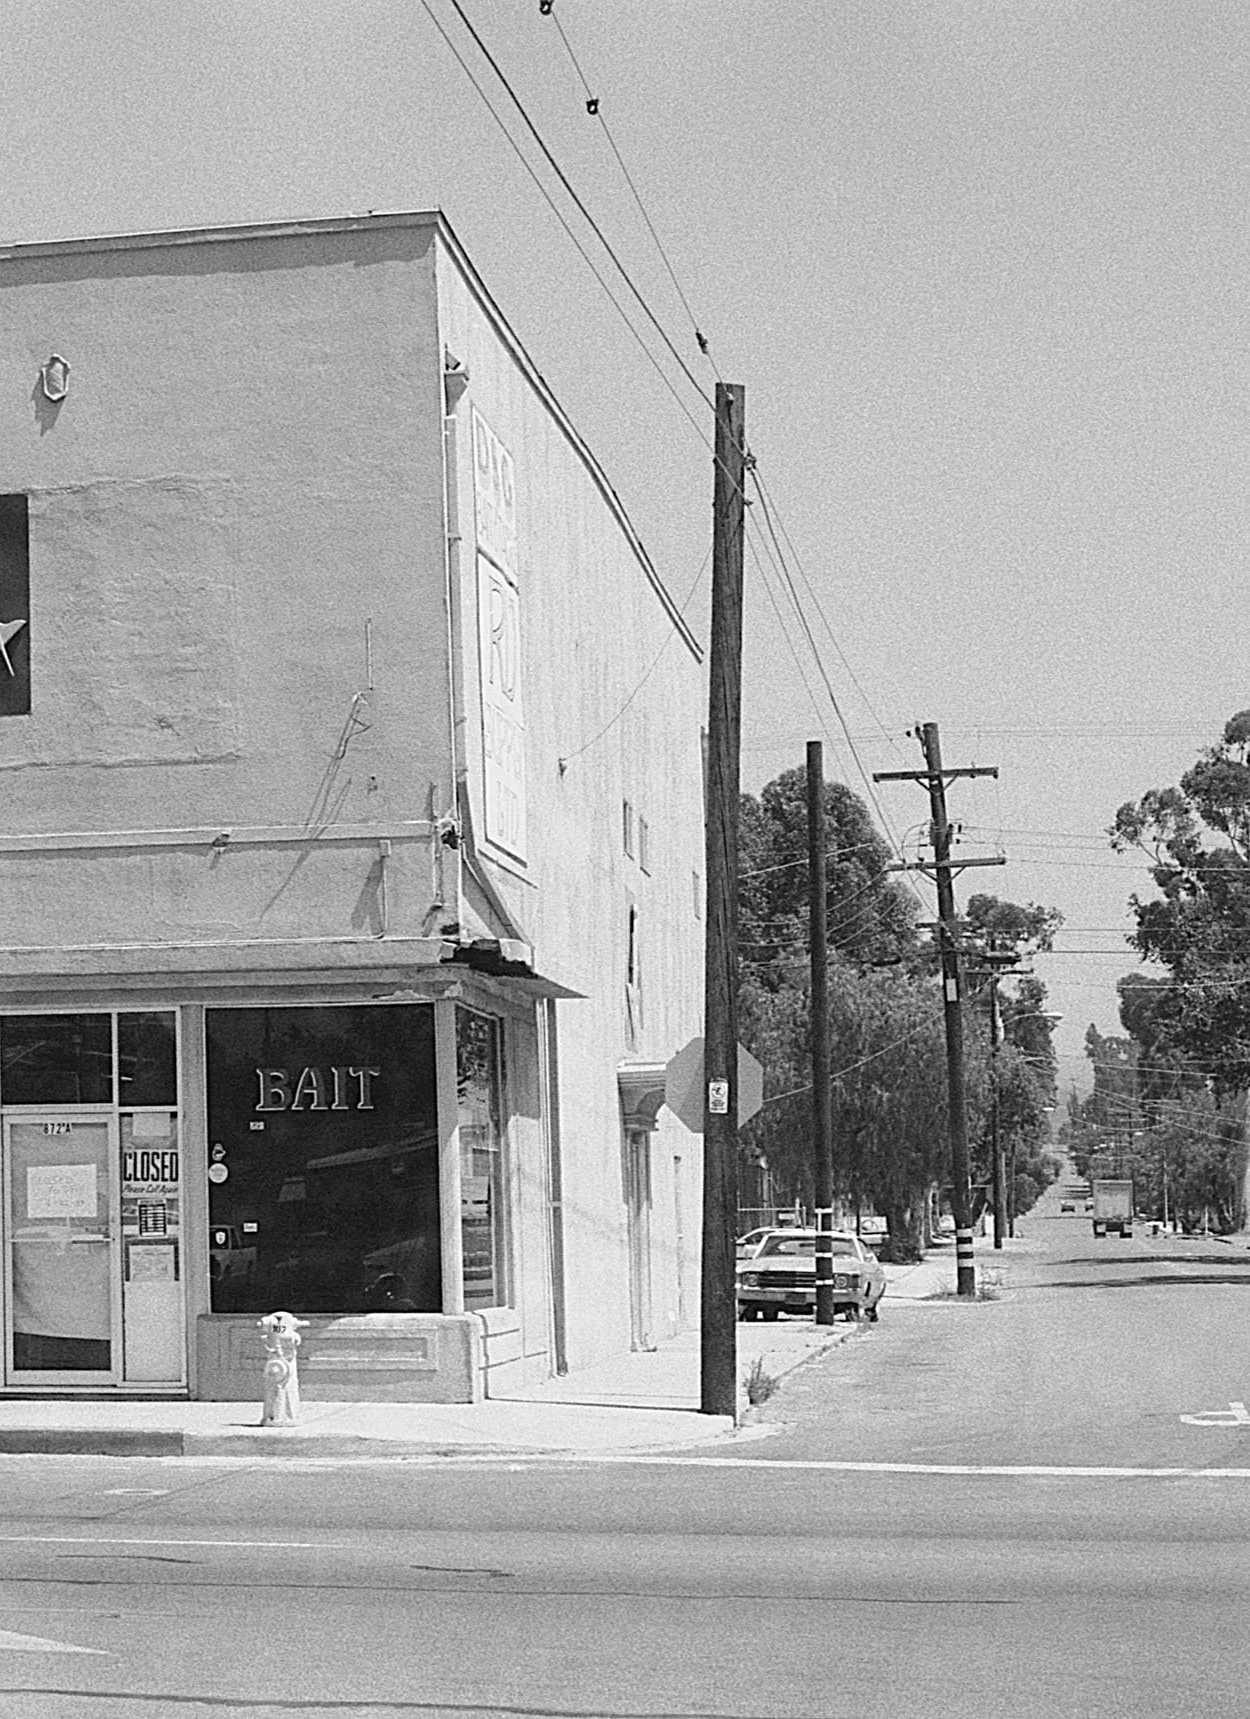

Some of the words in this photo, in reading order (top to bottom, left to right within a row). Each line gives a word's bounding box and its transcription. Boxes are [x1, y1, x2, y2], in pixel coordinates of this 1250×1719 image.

[255, 1065, 381, 1112] BAIT
[123, 1151, 179, 1182] CLOSED
[123, 1183, 145, 1193] Please
[146, 1183, 160, 1194] Call
[159, 1184, 179, 1196] Again
